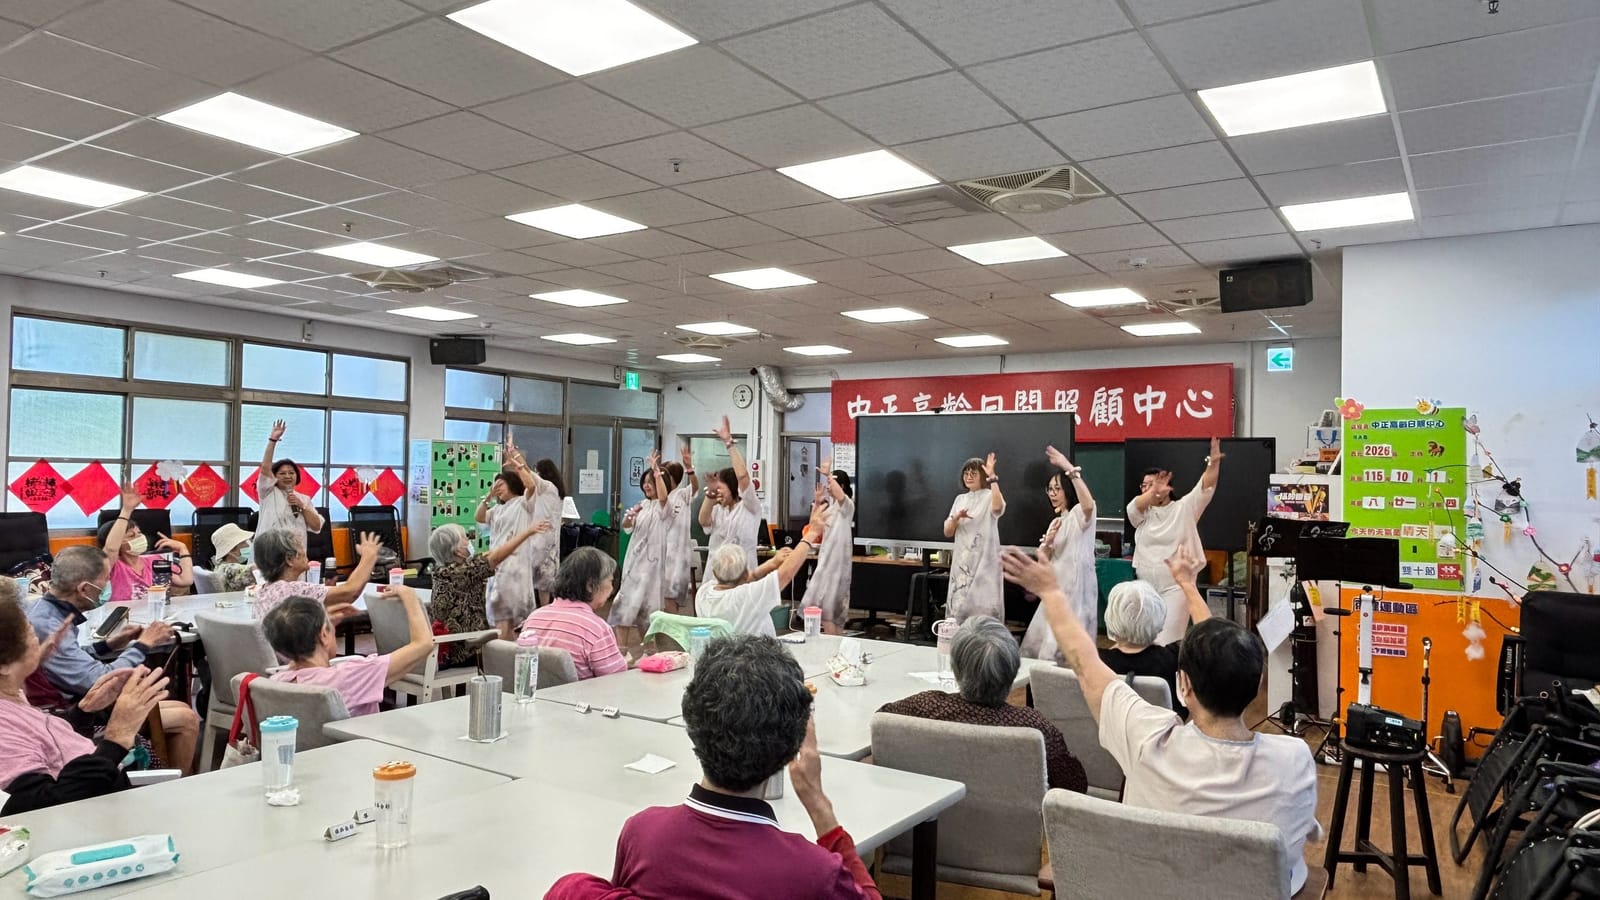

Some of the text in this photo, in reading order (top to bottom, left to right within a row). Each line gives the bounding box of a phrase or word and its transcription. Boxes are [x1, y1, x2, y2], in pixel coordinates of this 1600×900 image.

[1365, 445, 1390, 456] 2026
[1365, 471, 1383, 481] 115
[1397, 471, 1408, 482] 10
